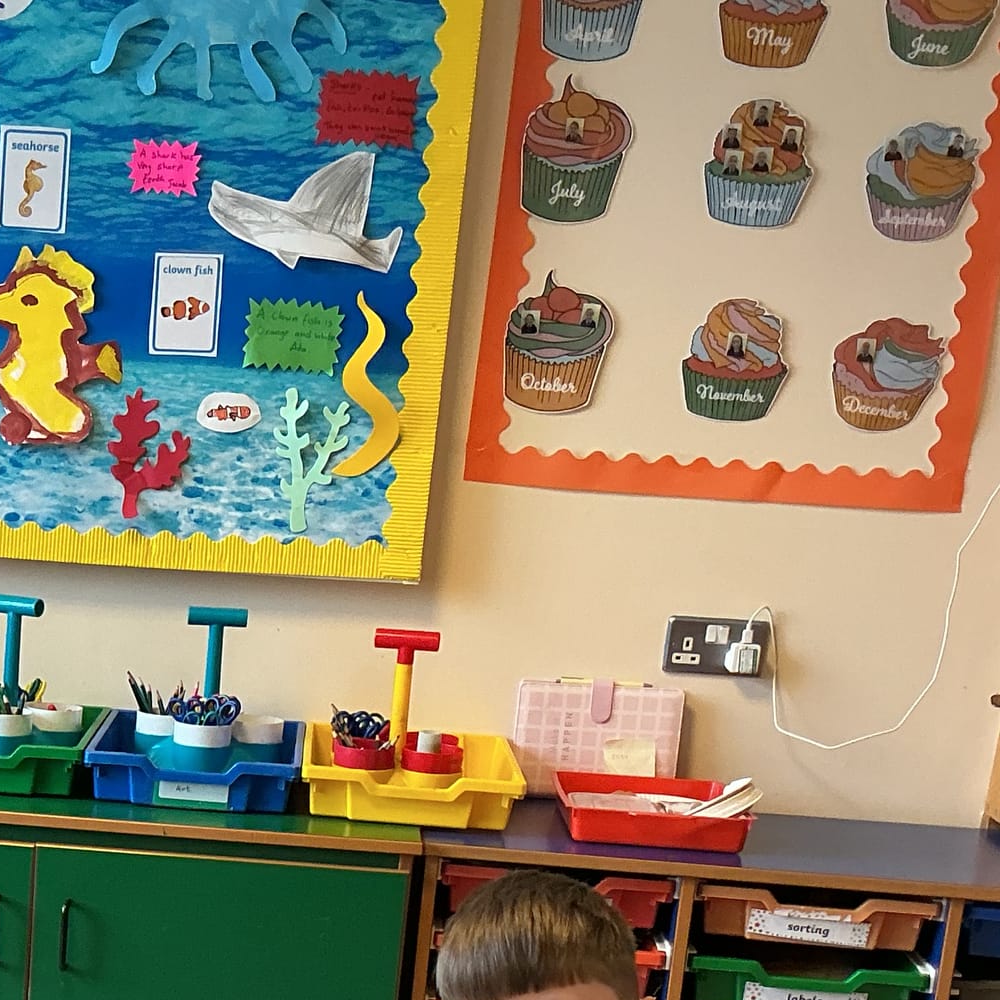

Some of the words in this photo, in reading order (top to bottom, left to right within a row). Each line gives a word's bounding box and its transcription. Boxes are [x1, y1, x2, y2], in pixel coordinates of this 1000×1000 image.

[564, 23, 615, 48] April
[746, 26, 794, 55] May
[907, 33, 951, 59] June
[11, 140, 60, 153] seahorse
[140, 148, 146, 158] A
[548, 179, 586, 207] July
[721, 190, 783, 218] August
[878, 208, 947, 229] September
[163, 264, 192, 275] clown
[194, 264, 213, 277] fish
[256, 307, 265, 320] A
[520, 372, 577, 394] October
[696, 383, 765, 403] November
[842, 395, 911, 421] December
[561, 711, 574, 762] HAPPEN
[175, 784, 191, 793] Art
[787, 923, 830, 938] sorting
